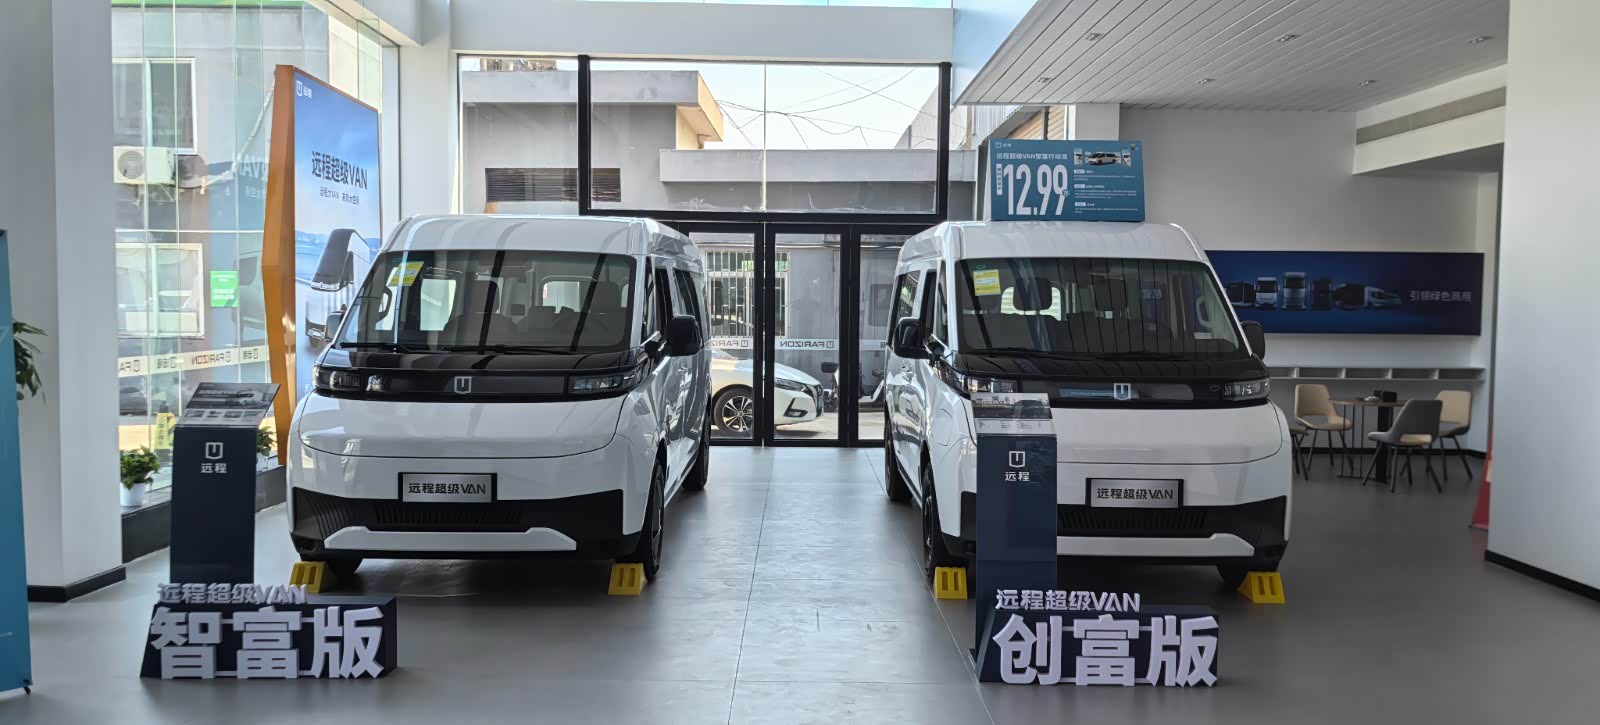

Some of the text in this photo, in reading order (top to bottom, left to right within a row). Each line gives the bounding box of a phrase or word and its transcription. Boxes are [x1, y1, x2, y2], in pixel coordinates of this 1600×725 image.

[311, 150, 368, 190] 远程超级VAN
[1003, 163, 1068, 216] 12.99
[200, 462, 228, 474] 远程
[1004, 471, 1031, 482] 远程
[408, 482, 486, 494] 远程超级VAN
[1096, 488, 1174, 500] 远程超级VAN
[157, 582, 308, 604] 远程超级VAN
[995, 589, 1141, 612] 远程超级VAN
[150, 606, 384, 680] 智富版
[993, 613, 1219, 687] 创富版
